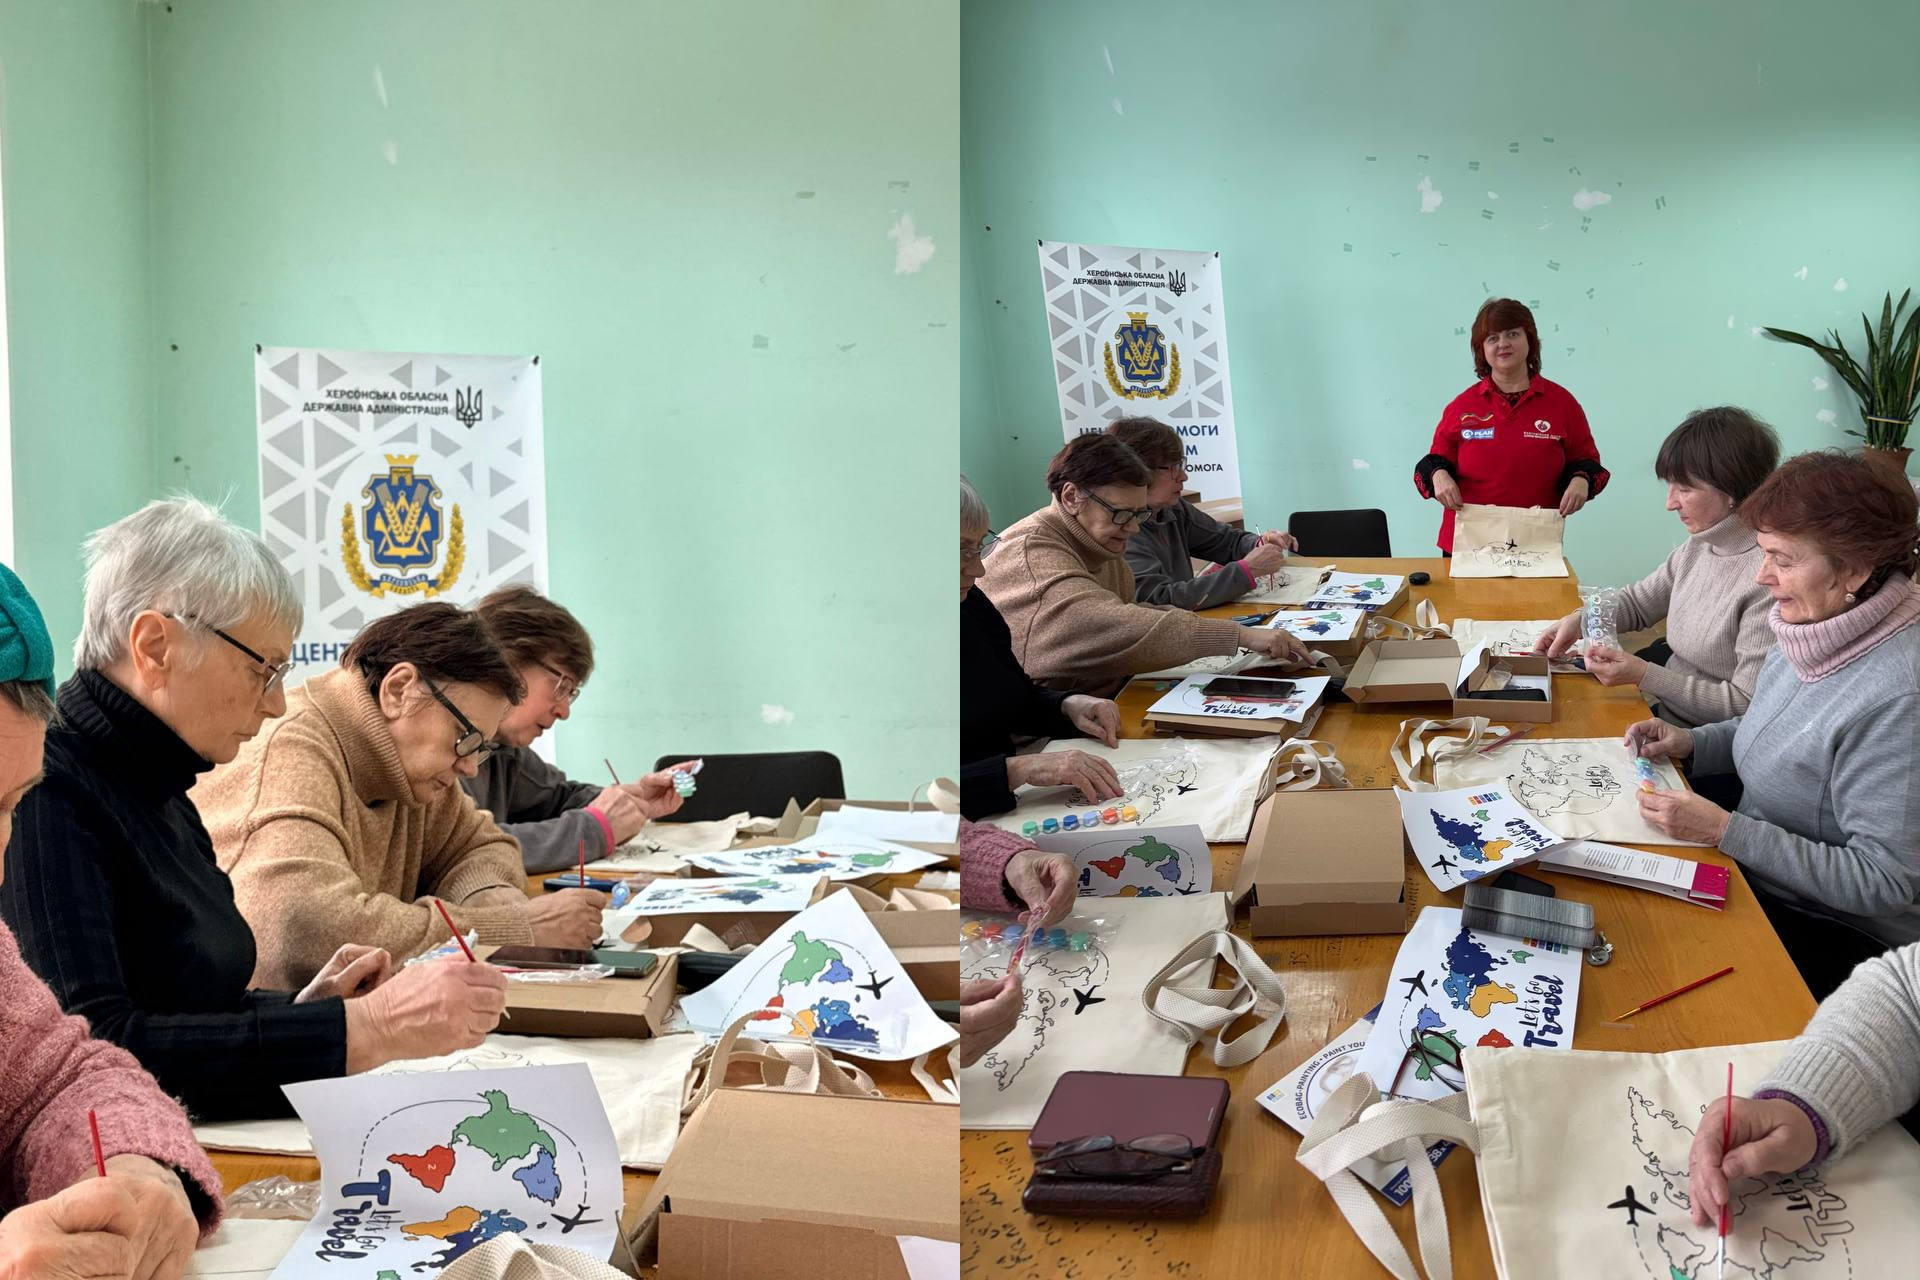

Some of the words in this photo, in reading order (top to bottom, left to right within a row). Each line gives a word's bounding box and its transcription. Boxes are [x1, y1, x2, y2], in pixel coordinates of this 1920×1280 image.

[1086, 269, 1132, 279] ХЕРСОНСЬКА
[1134, 271, 1165, 280] ОБЛАСНА
[1072, 278, 1112, 286] ДЕРЖАВНА
[1113, 279, 1165, 288] АДМІНІСТРАЦІЯ
[326, 389, 397, 401] ХЕРСОНСЬКА
[400, 391, 449, 402] ОБЛАСНА
[302, 402, 364, 413] ДЕРЖАВНА
[367, 404, 449, 416] АДМІНІСТРАЦІЯ
[1474, 429, 1493, 437] PLAN
[1185, 463, 1224, 473] ОМОГА
[292, 642, 350, 666] ЦЕНТ
[1515, 1000, 1541, 1029] Let's
[1523, 974, 1564, 1048] Travel
[1322, 1045, 1346, 1060] PAINT
[427, 1163, 437, 1171] 2
[537, 1177, 546, 1185] 3
[315, 1168, 392, 1262] Travel
[364, 1208, 405, 1234] Let's
[355, 1235, 387, 1250] Go
